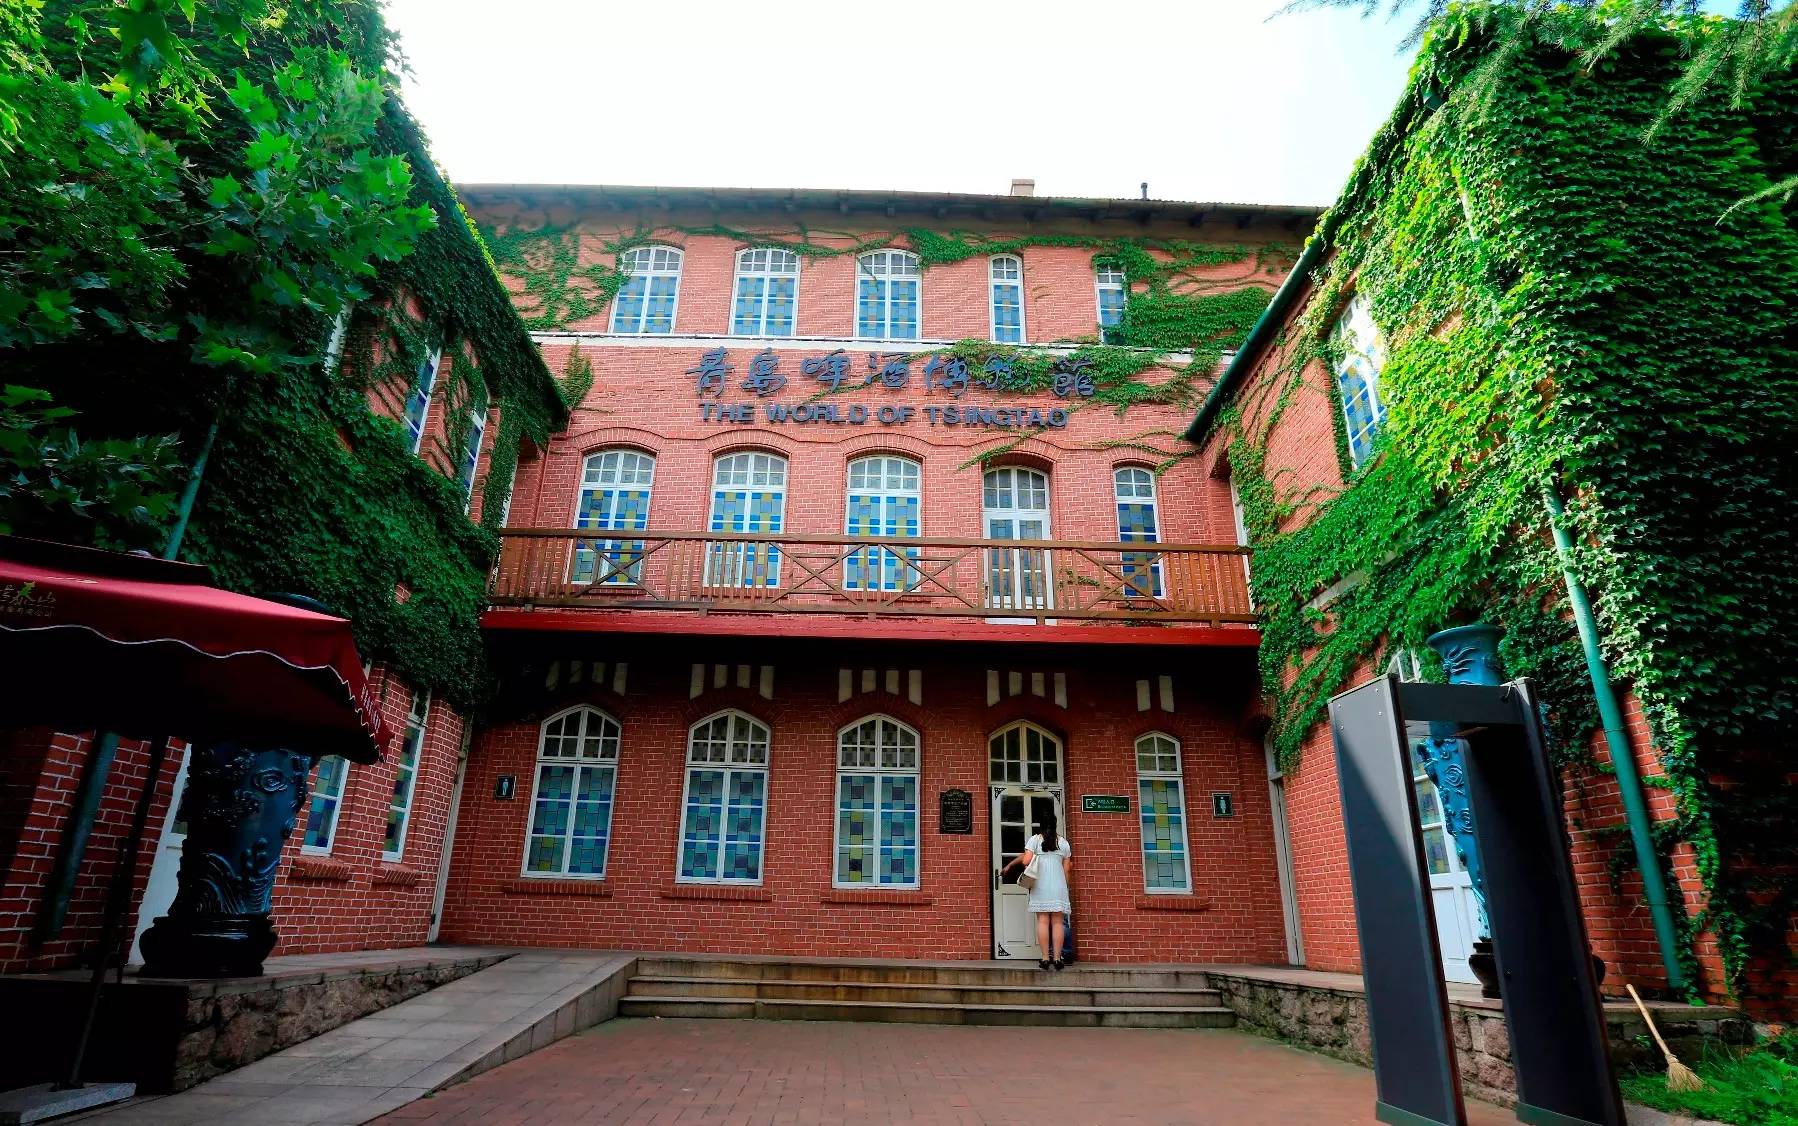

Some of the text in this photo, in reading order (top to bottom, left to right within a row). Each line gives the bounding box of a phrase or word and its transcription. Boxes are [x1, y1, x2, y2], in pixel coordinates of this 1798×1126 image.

[699, 402, 1069, 428] THE WORLD OF TSINGTAO
